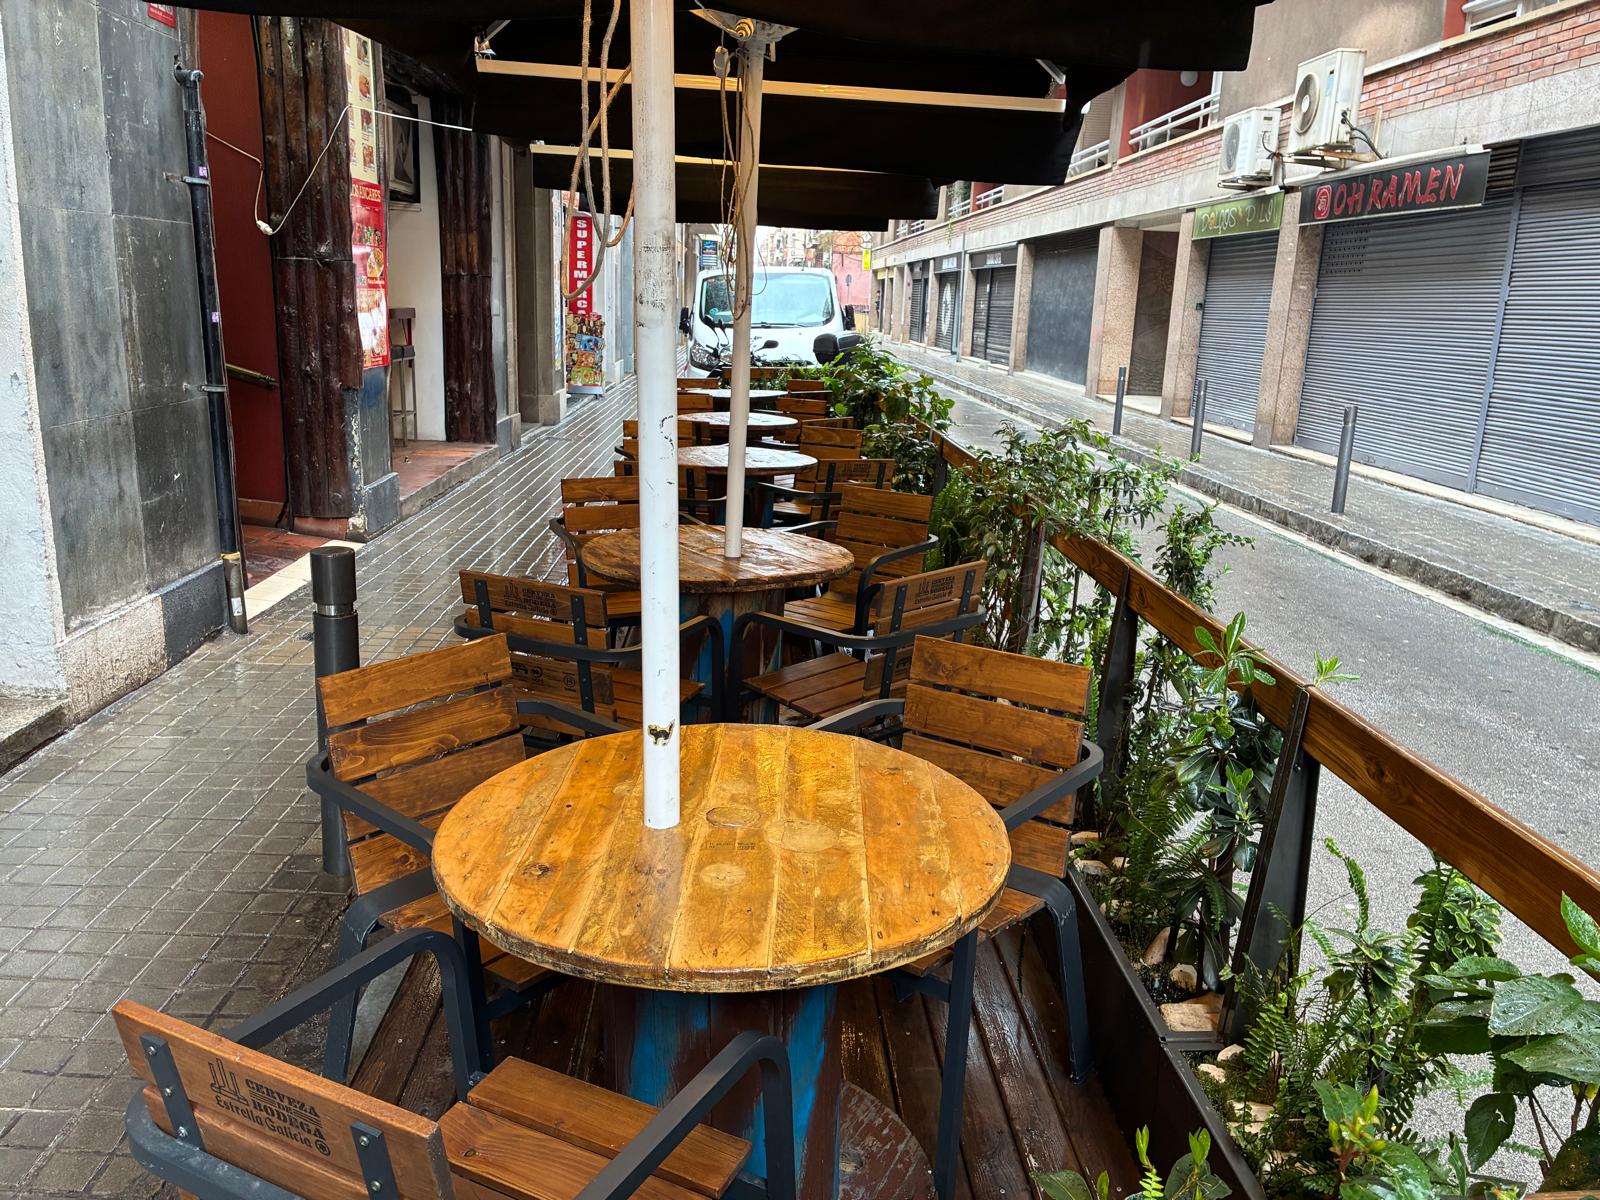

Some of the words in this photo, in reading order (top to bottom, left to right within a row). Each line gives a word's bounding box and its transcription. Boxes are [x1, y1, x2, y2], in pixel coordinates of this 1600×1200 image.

[1333, 182, 1366, 216] OH
[1367, 163, 1464, 211] RAMEN
[245, 1078, 320, 1119] CERVEZA
[277, 1102, 292, 1115] DE
[215, 1095, 264, 1127] Estrella
[264, 1118, 313, 1149] Galicia
[251, 1100, 327, 1141] BODEGA
